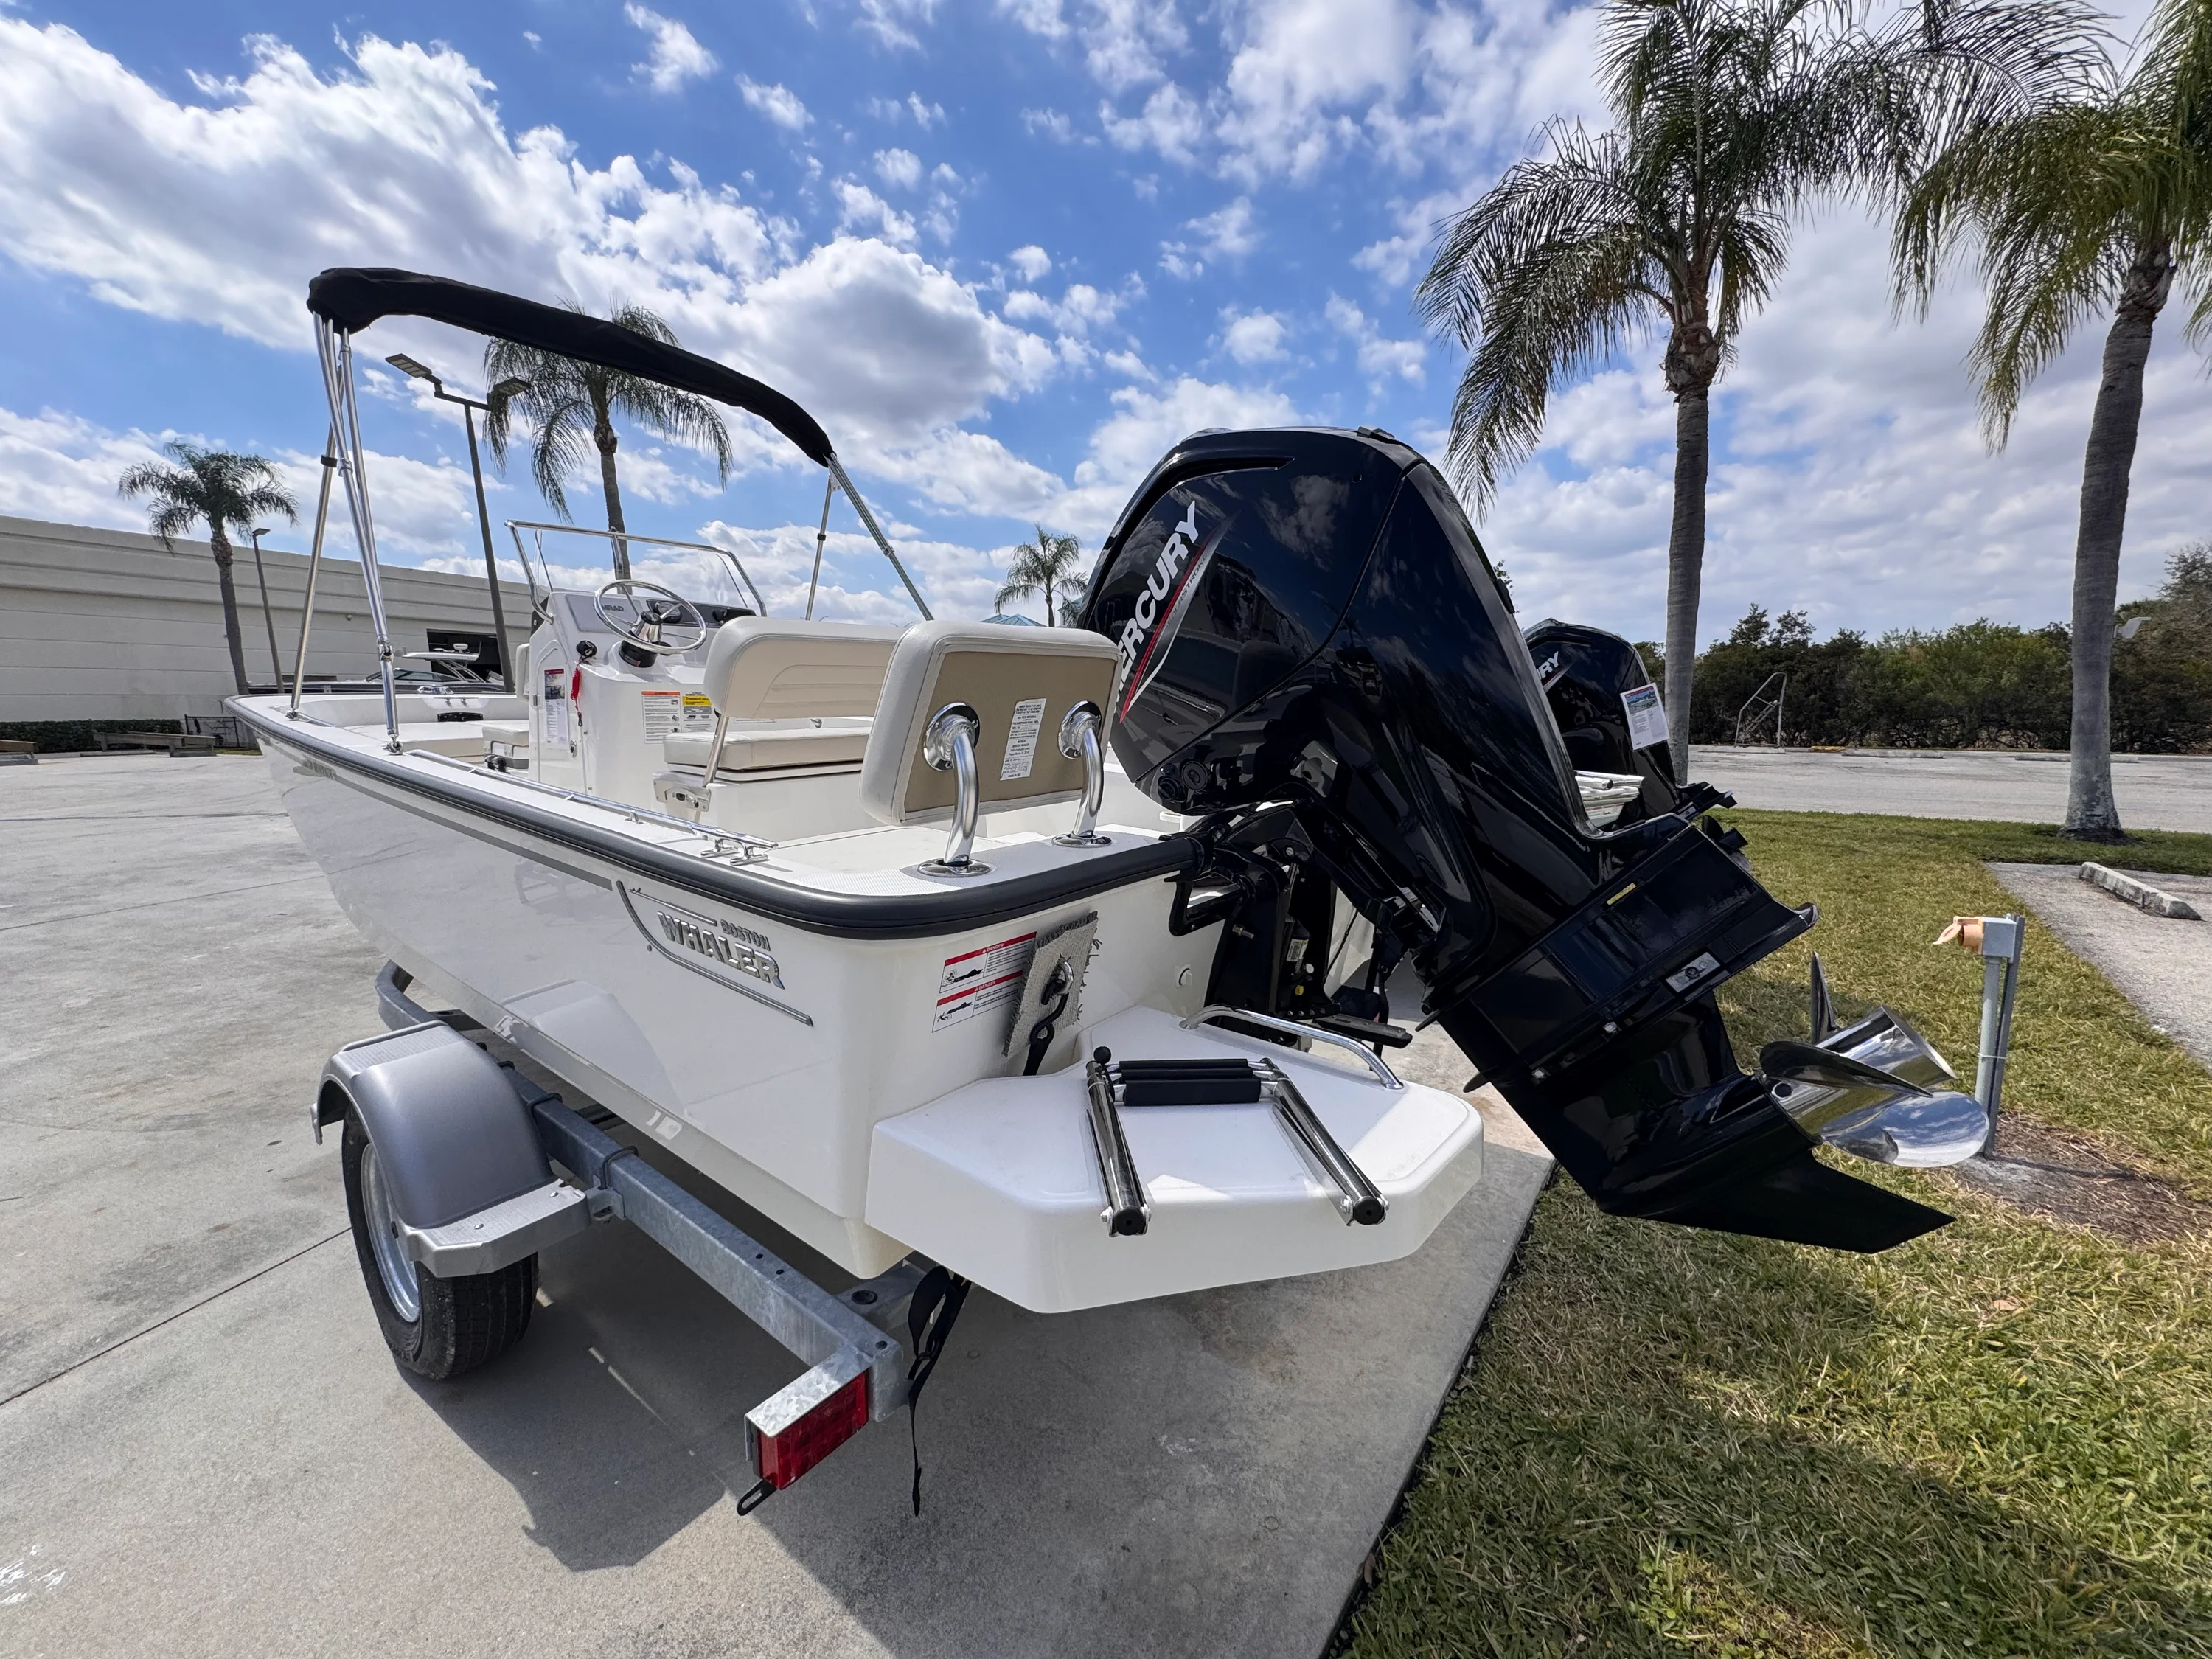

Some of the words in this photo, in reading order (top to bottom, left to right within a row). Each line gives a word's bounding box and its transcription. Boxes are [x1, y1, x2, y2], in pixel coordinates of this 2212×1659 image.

[1166, 554, 1208, 627] FOURSTROKE
[656, 911, 786, 990] WHALER
[720, 919, 771, 951] BOSTON
